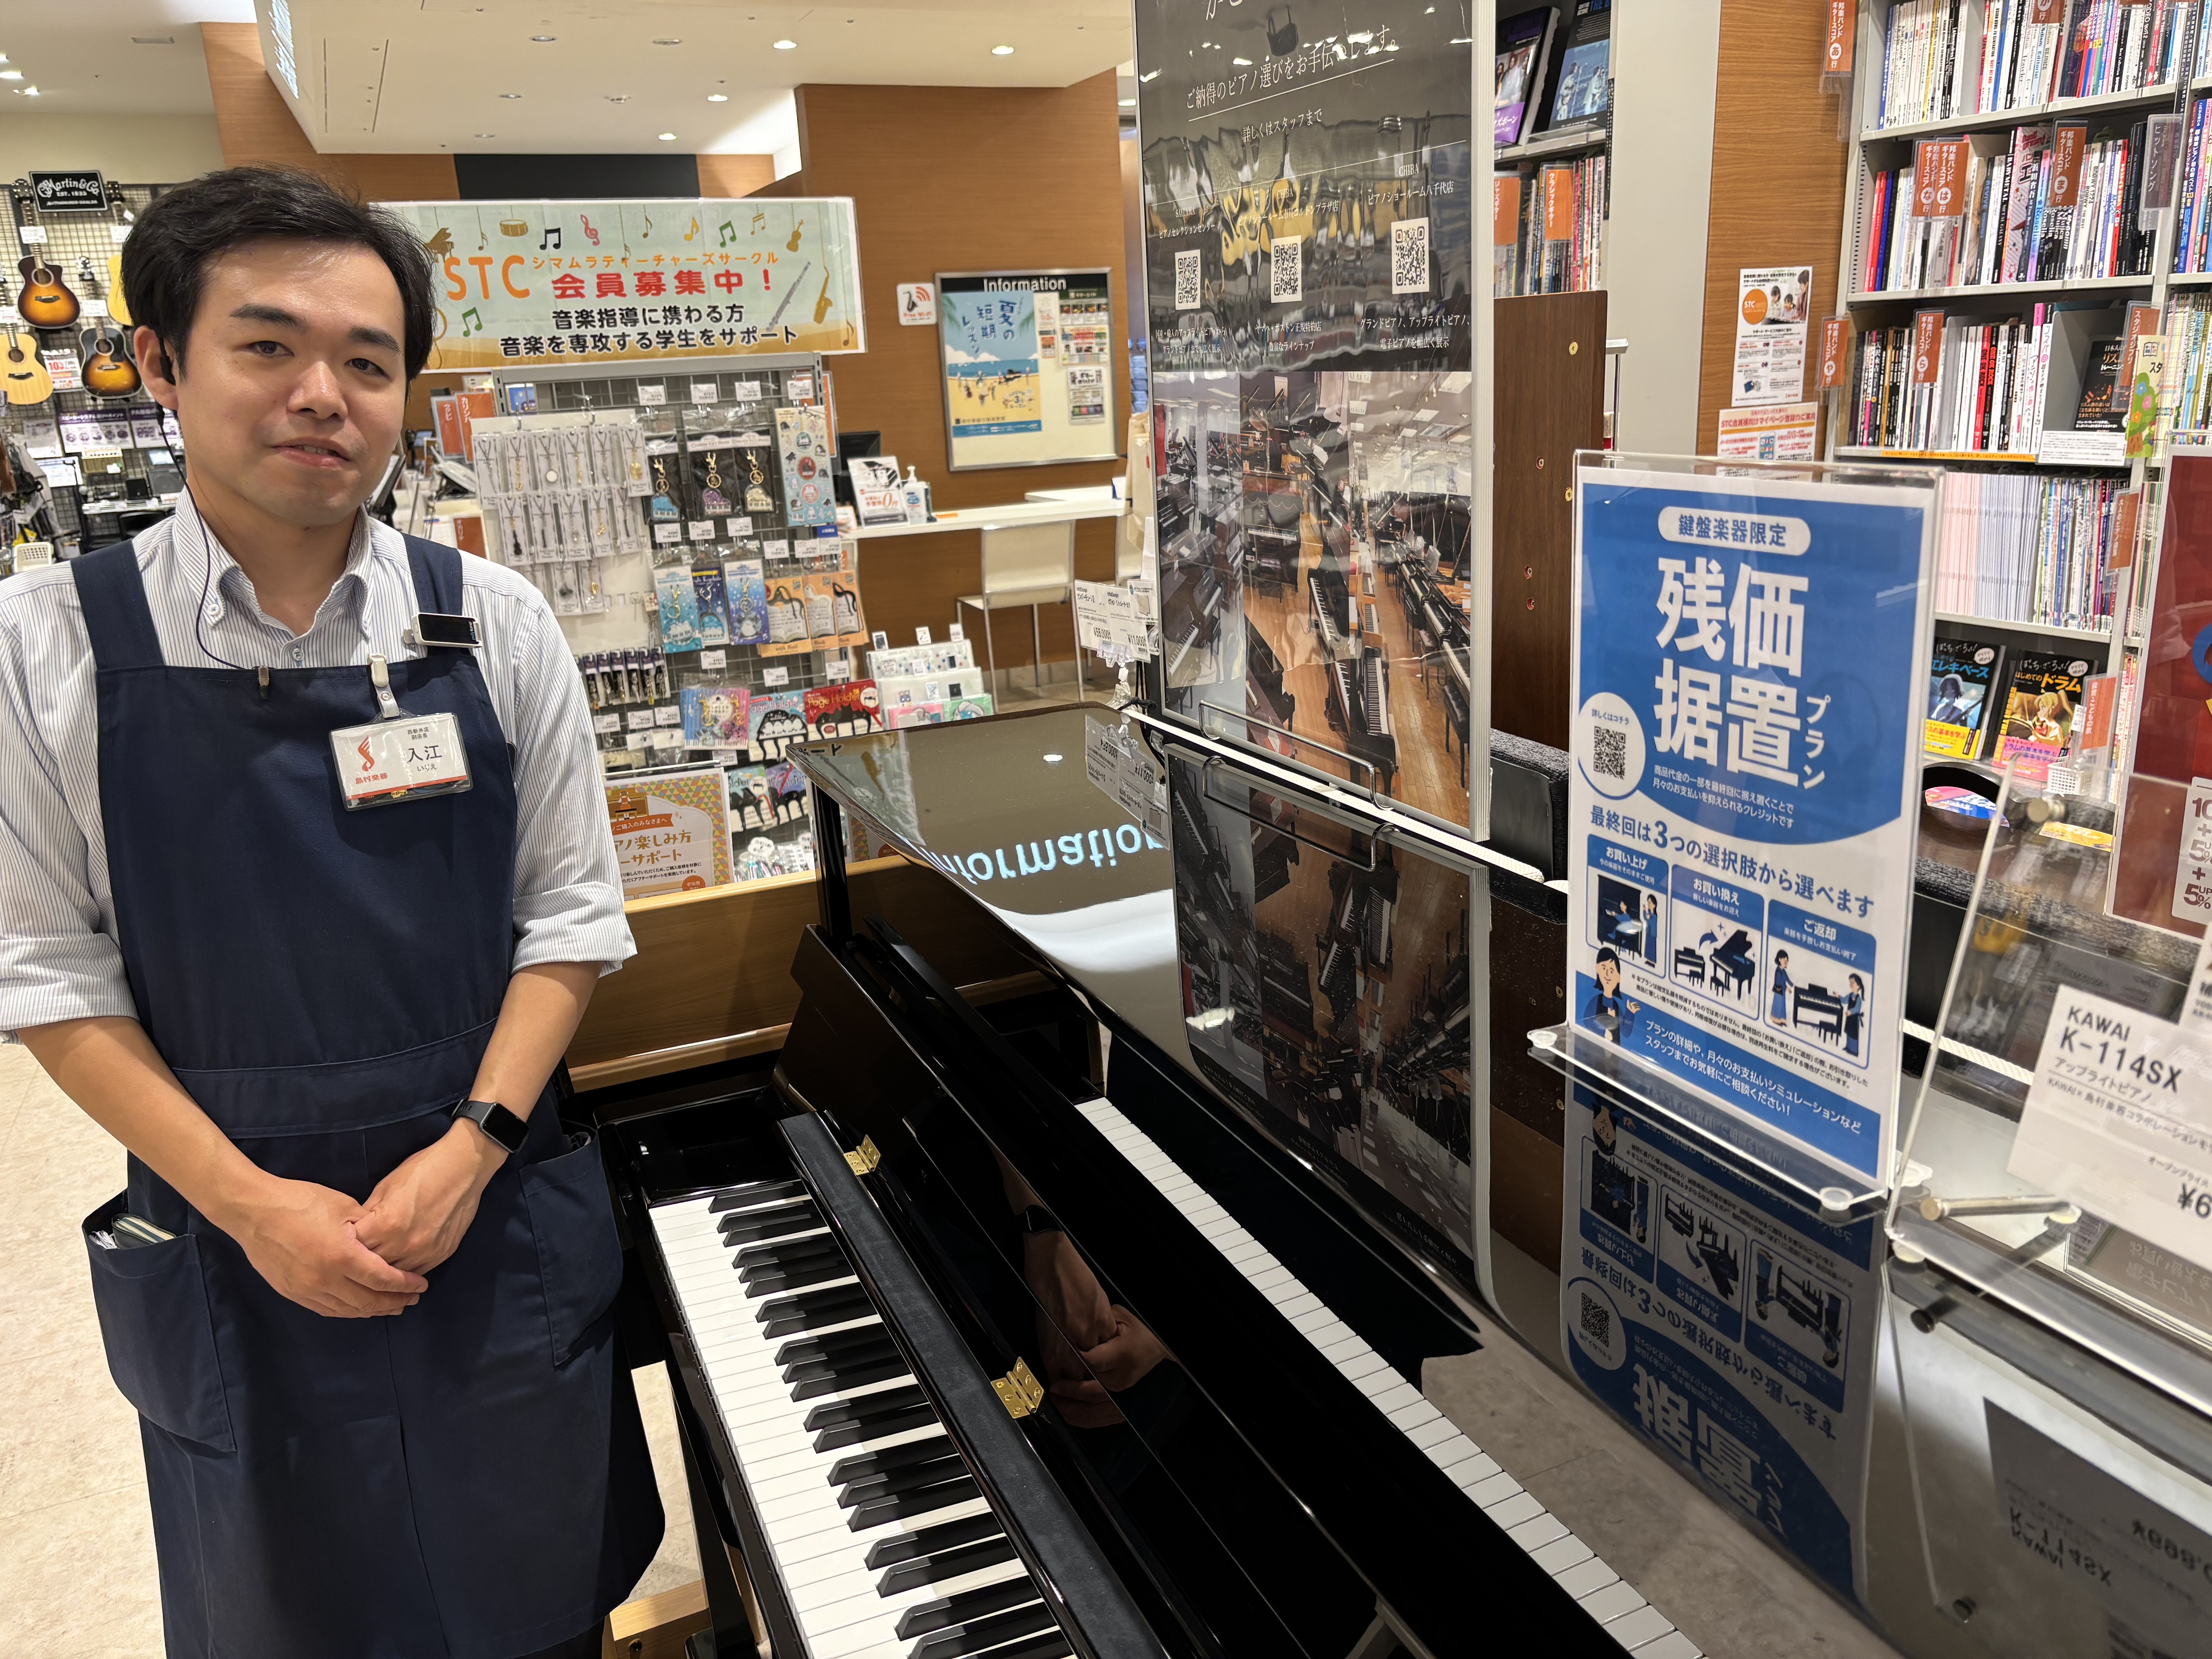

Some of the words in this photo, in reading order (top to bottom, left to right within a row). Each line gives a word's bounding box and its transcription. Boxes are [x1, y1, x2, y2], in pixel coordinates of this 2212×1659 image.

[1831, 1, 1839, 43] ギタースコア
[1242, 108, 1323, 142] 詳しくはスタッフまで
[1939, 145, 1949, 187] ギタースコア
[2056, 130, 2068, 176] ギタースコア
[2064, 131, 2074, 170] 邦楽バンド
[2148, 125, 2161, 192] ヒットソング
[1398, 163, 1419, 176] CHIBA
[1277, 188, 1293, 199] CHIBA
[1368, 180, 1454, 206] ピアノショールーム八千代店
[532, 251, 779, 270] シマムラティーチャーズサークル
[443, 254, 531, 301] STC
[551, 269, 772, 301] 会員募集中！
[983, 276, 1066, 292] Information
[552, 303, 745, 331] 音楽指導に携わる方
[999, 300, 1018, 341] 夏の
[1360, 314, 1470, 330] グランドピアノ、アップライトピアノ、
[500, 326, 798, 358] 音楽を専攻する学生をサポート
[1379, 337, 1449, 349] 電子ピアノを幅広く展示
[2128, 310, 2141, 364] スタジオジブリ
[1986, 369, 1995, 386] ROCK
[1678, 513, 1787, 548] 鍵盤楽器限定
[1655, 556, 1809, 678] 残価
[2041, 673, 2081, 693] ドラム
[807, 697, 830, 709] Page
[1592, 708, 1630, 725] 詳しくはコチラ
[1653, 658, 1801, 788] 据置
[407, 745, 443, 764] 入江
[1803, 694, 1831, 790] プラン
[355, 772, 388, 784] 島村楽器
[417, 763, 437, 771] いりえ
[1652, 777, 1794, 829] 月々のお支払いを抑えられるクレジットです
[1654, 764, 1794, 815] 商品代金の一部を最終回に据え置くことで
[1590, 804, 1875, 920] 最終回は3つの選択肢から選べます
[1605, 846, 1649, 871] お買い上げ
[1693, 877, 1740, 906] お買い換え
[1803, 918, 1837, 942] ご返却
[2067, 1005, 2131, 1042] KAWAI
[2060, 1026, 2183, 1093] K-114SX
[1646, 1020, 1862, 1135] プランの詳細や、月々のお支払いシミュレーションなど
[2054, 1056, 2152, 1103] アップライトピアノ
